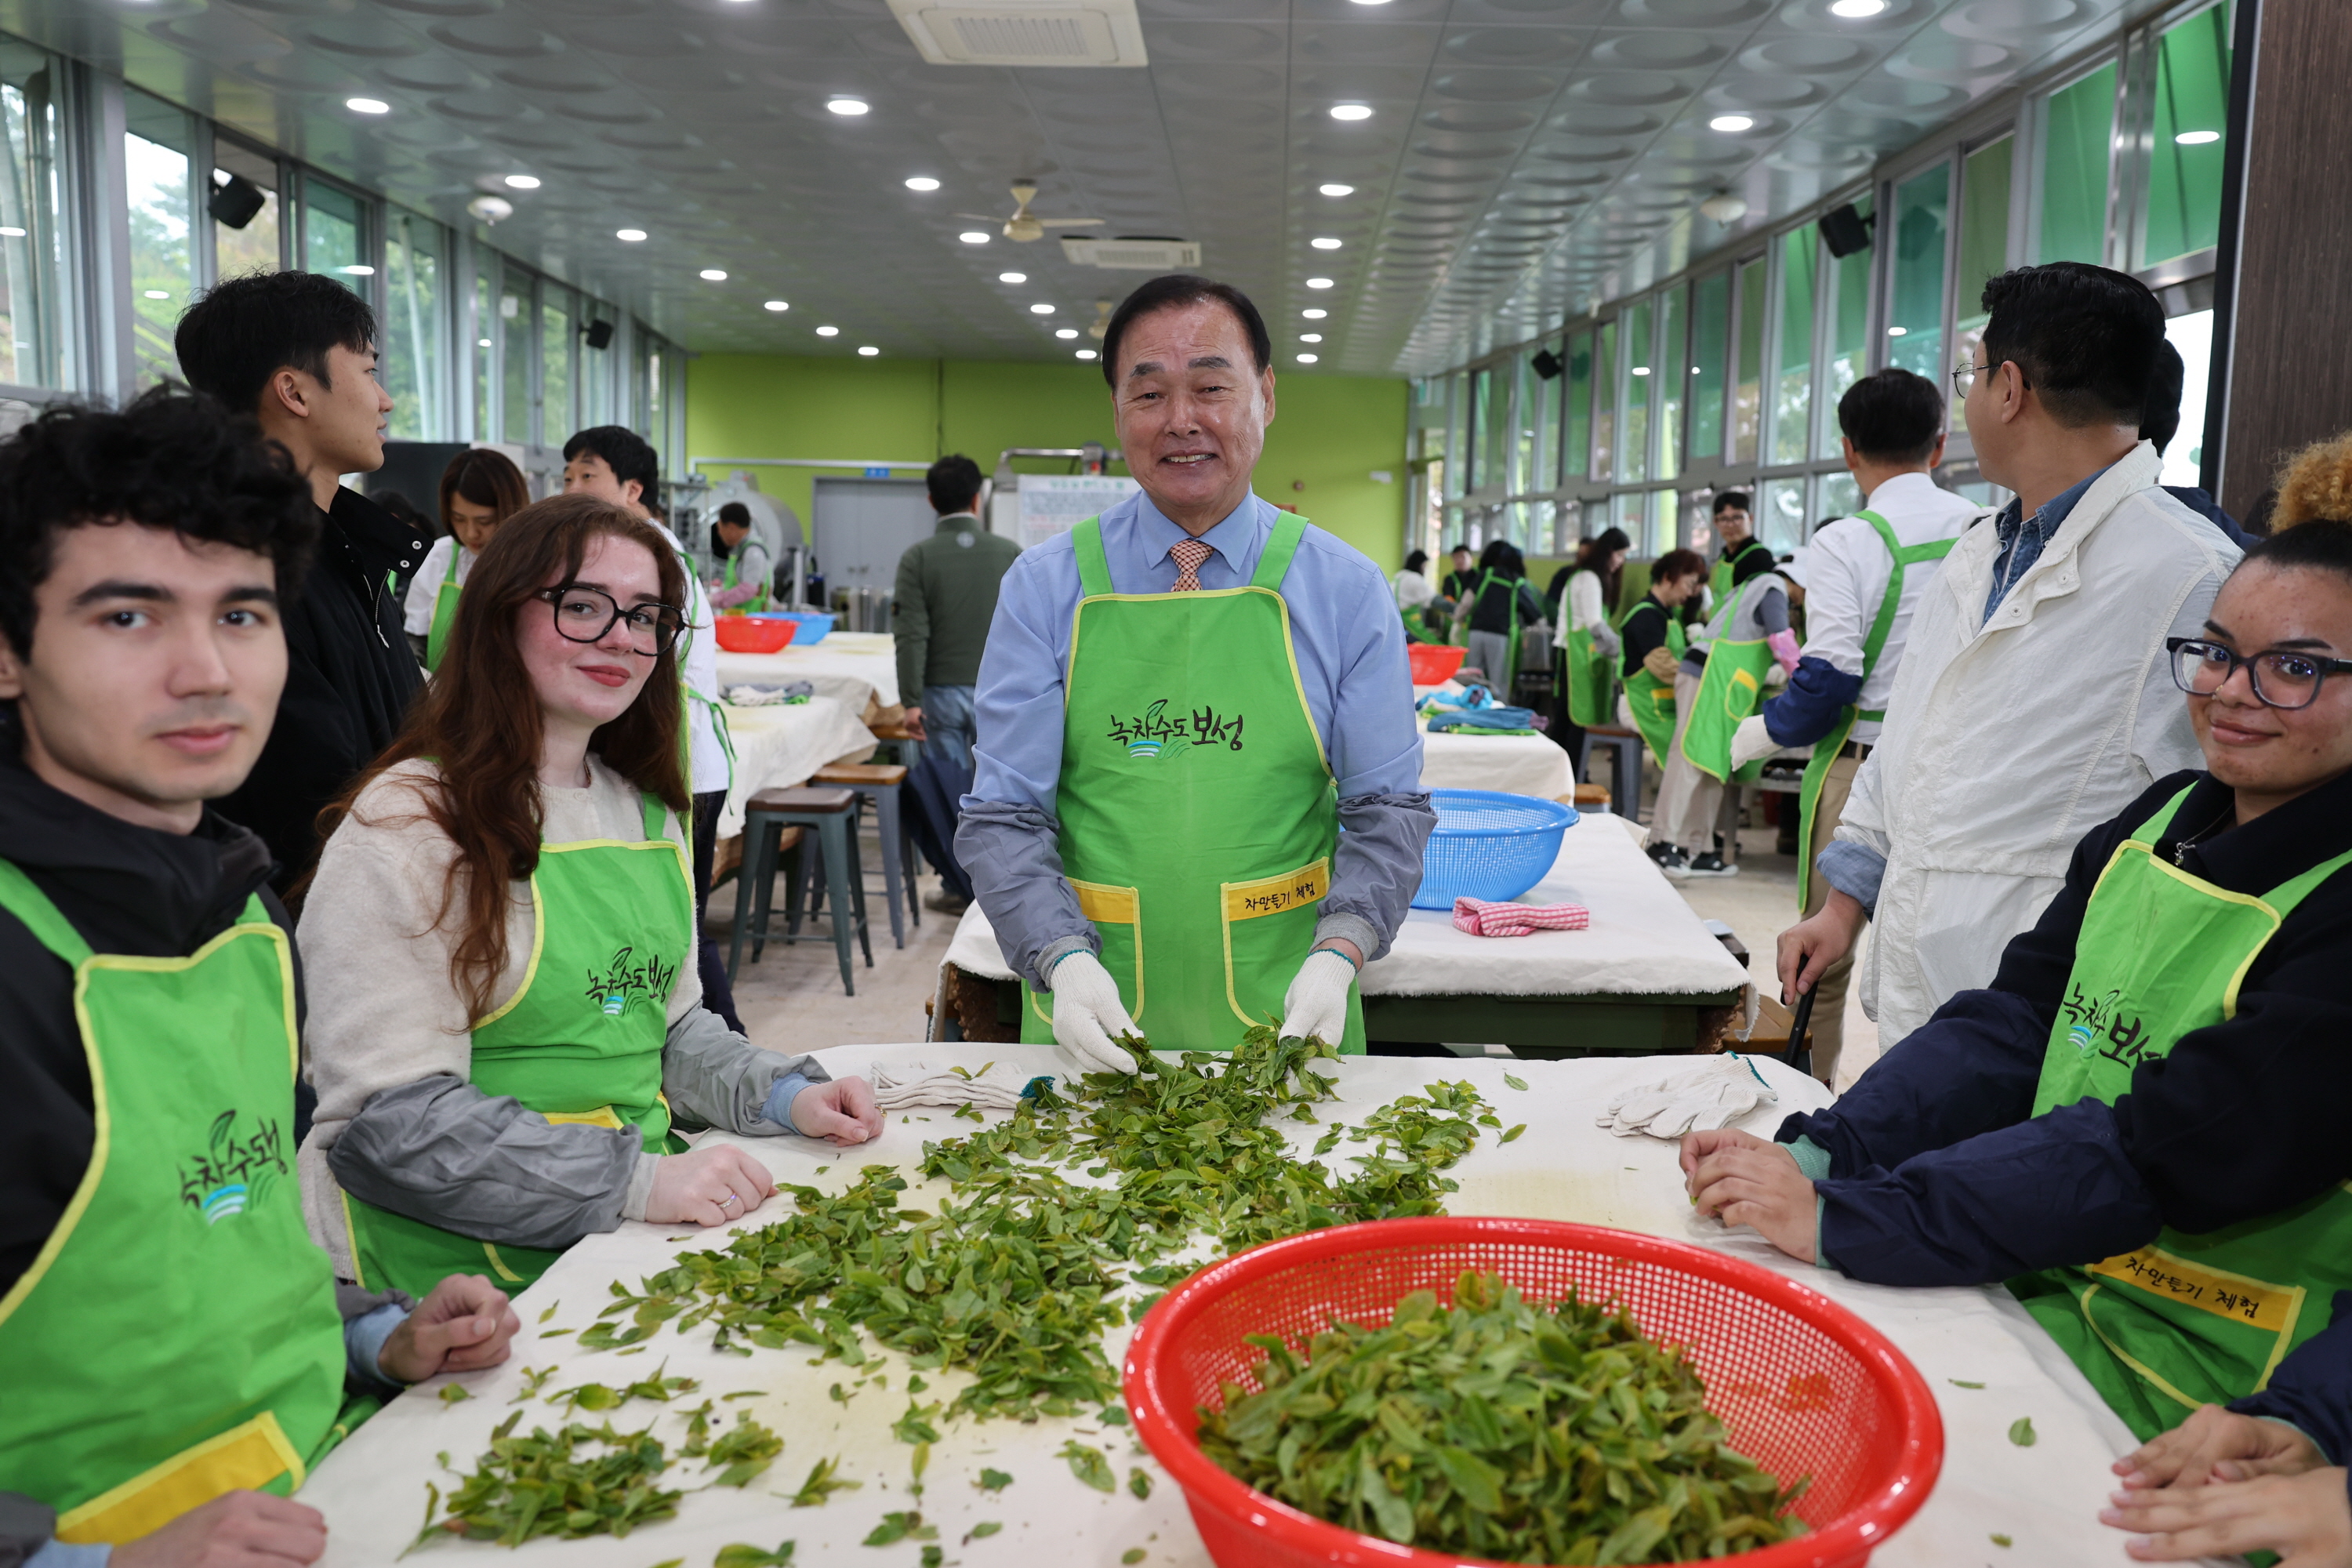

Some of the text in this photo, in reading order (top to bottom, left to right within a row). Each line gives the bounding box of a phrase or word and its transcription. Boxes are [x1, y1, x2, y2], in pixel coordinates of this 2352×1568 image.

[1107, 699, 1243, 751] 녹차수도 보성
[1245, 881, 1316, 911] 차만들기 체험
[2125, 1256, 2259, 1319] 차만들기 체험
